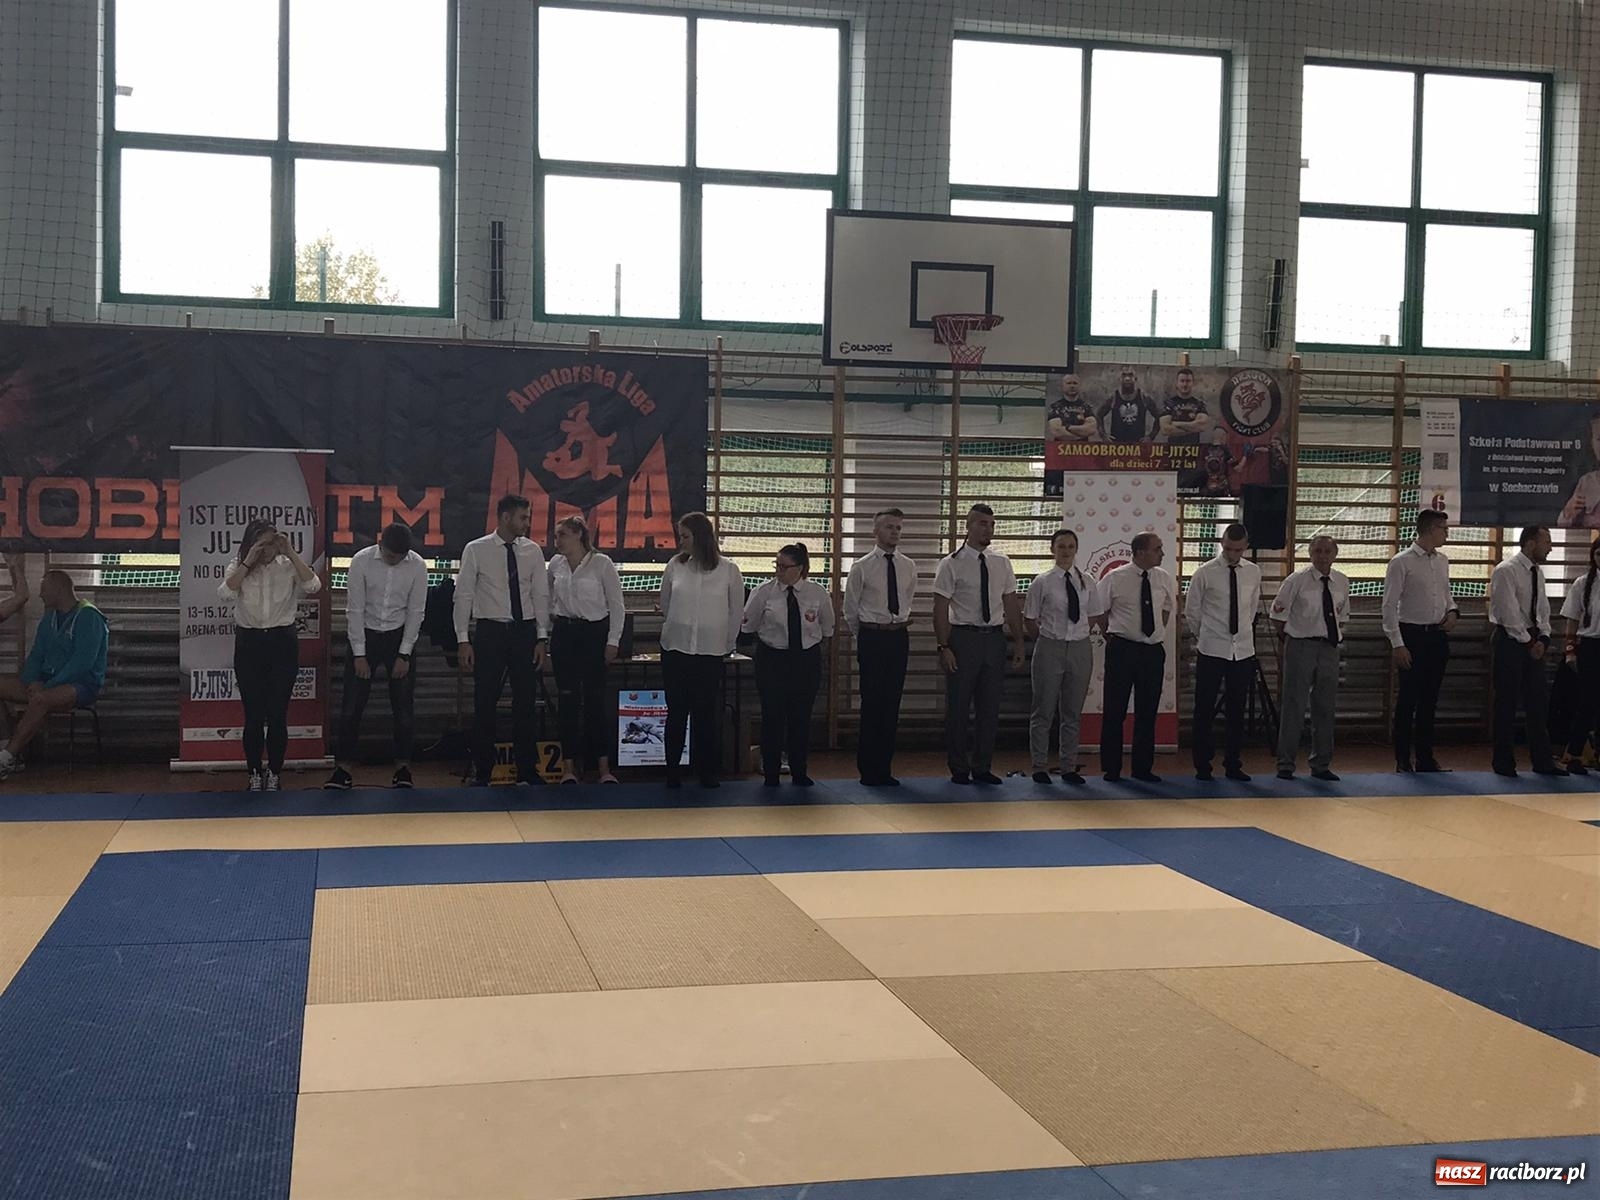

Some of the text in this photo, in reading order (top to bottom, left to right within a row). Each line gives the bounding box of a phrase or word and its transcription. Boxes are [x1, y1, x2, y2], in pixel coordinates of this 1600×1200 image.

[506, 364, 657, 416] Amatorska Liga
[1057, 444, 1200, 457] SAMOOBRONA JU-JITSU
[1469, 436, 1502, 447] Szkoła
[1505, 438, 1560, 449] Podstawowa
[1110, 459, 1124, 468] dla
[1127, 459, 1153, 469] dzieci
[1155, 460, 1161, 468] 7
[1171, 460, 1181, 468] 12
[1184, 459, 1196, 469] lat
[1431, 493, 1446, 512] 6
[188, 505, 320, 526] 1ST EUROPEAN
[194, 565, 225, 578] NO GI
[1089, 550, 1117, 578] OLSKI
[186, 624, 216, 636] ARENA
[544, 744, 562, 773] 2
